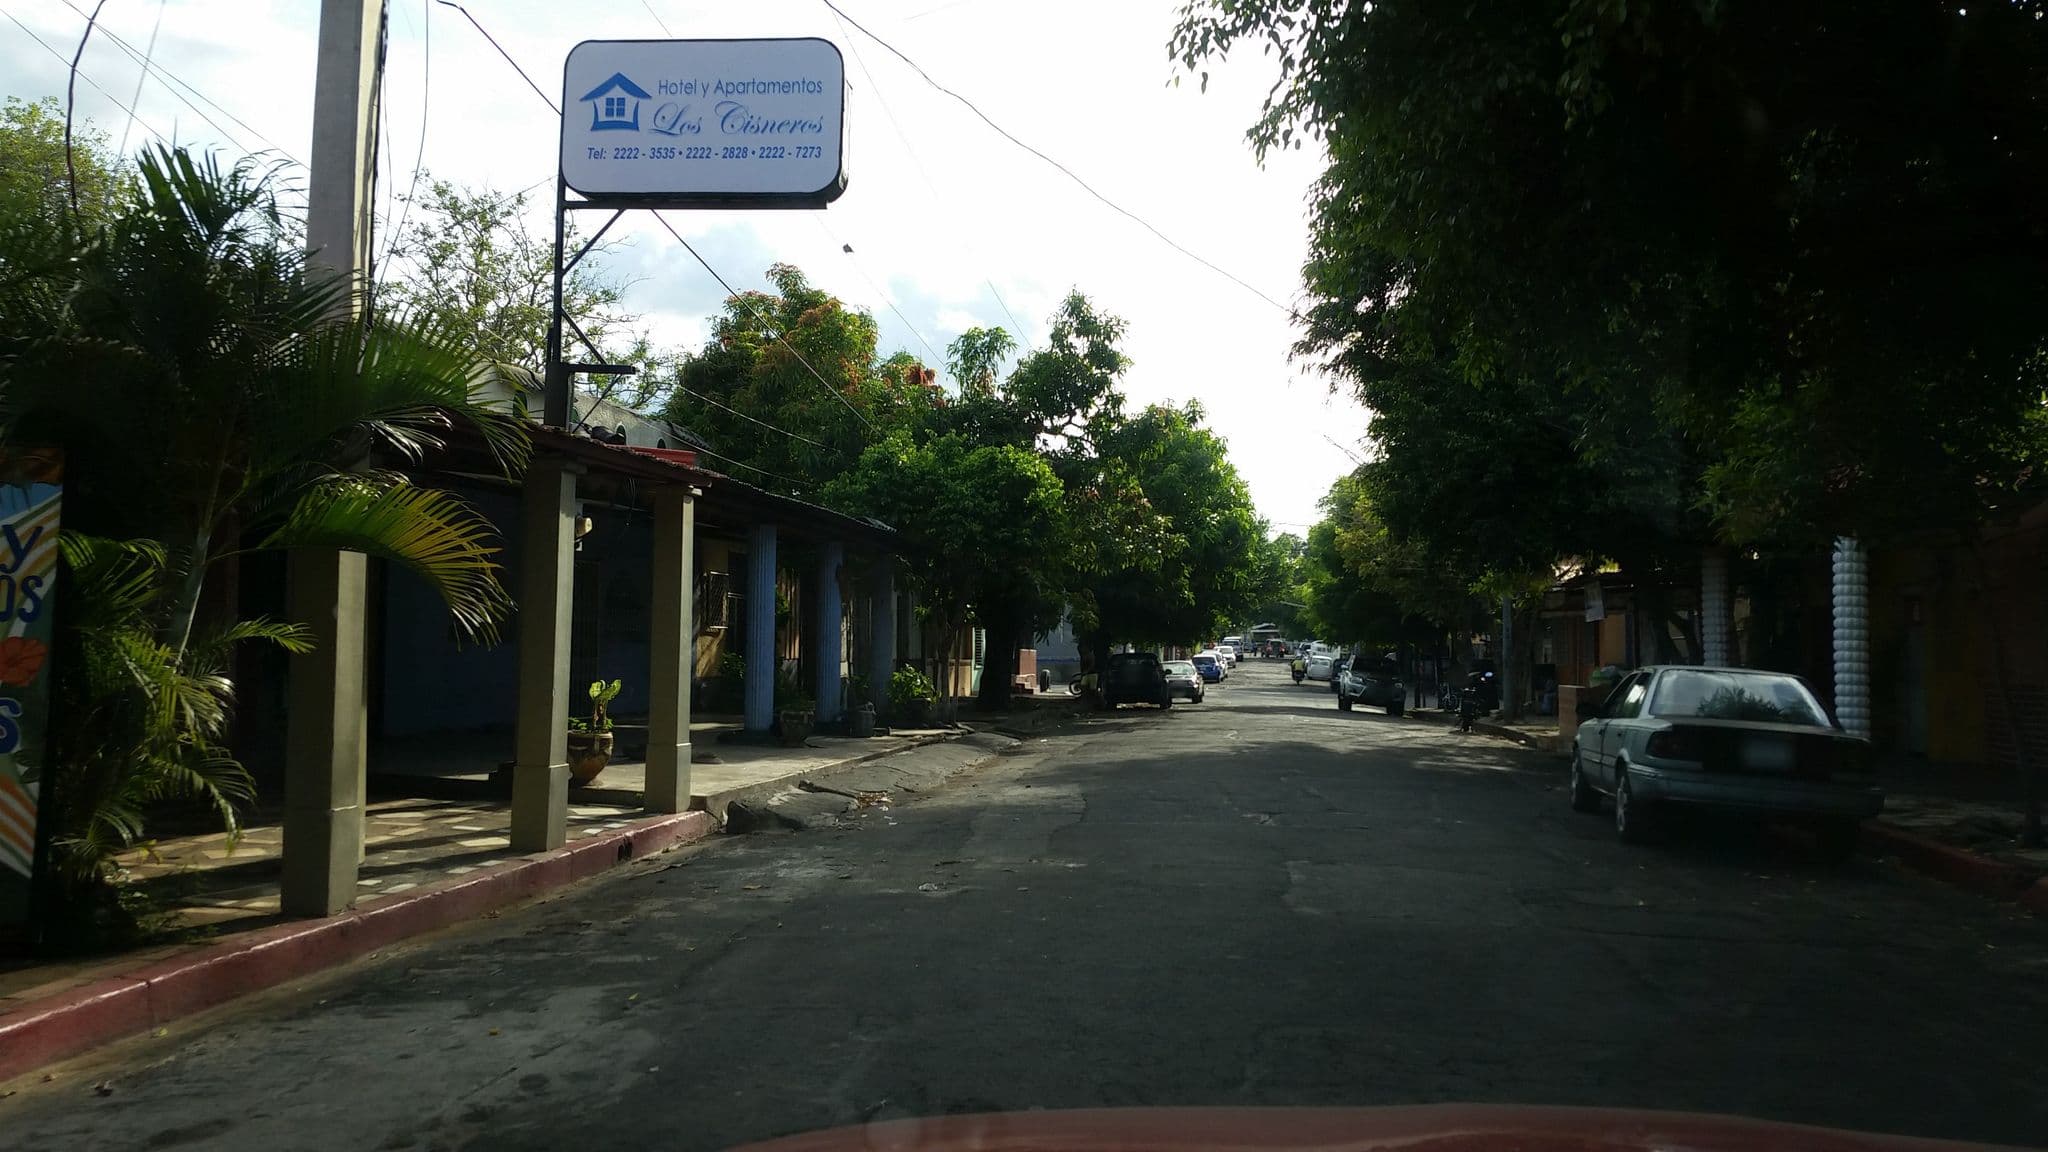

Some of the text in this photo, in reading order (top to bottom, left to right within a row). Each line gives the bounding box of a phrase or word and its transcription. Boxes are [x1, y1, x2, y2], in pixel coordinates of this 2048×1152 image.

[658, 77, 823, 98] Hotel y Apartamentos
[648, 100, 824, 136] Los Cisneros
[587, 147, 607, 159] Tel:
[613, 147, 640, 159] 2222
[649, 147, 676, 159] 3535
[686, 147, 712, 159] 2222
[722, 147, 748, 159] 2828
[759, 146, 785, 159] 2222
[796, 146, 822, 158] 7273
